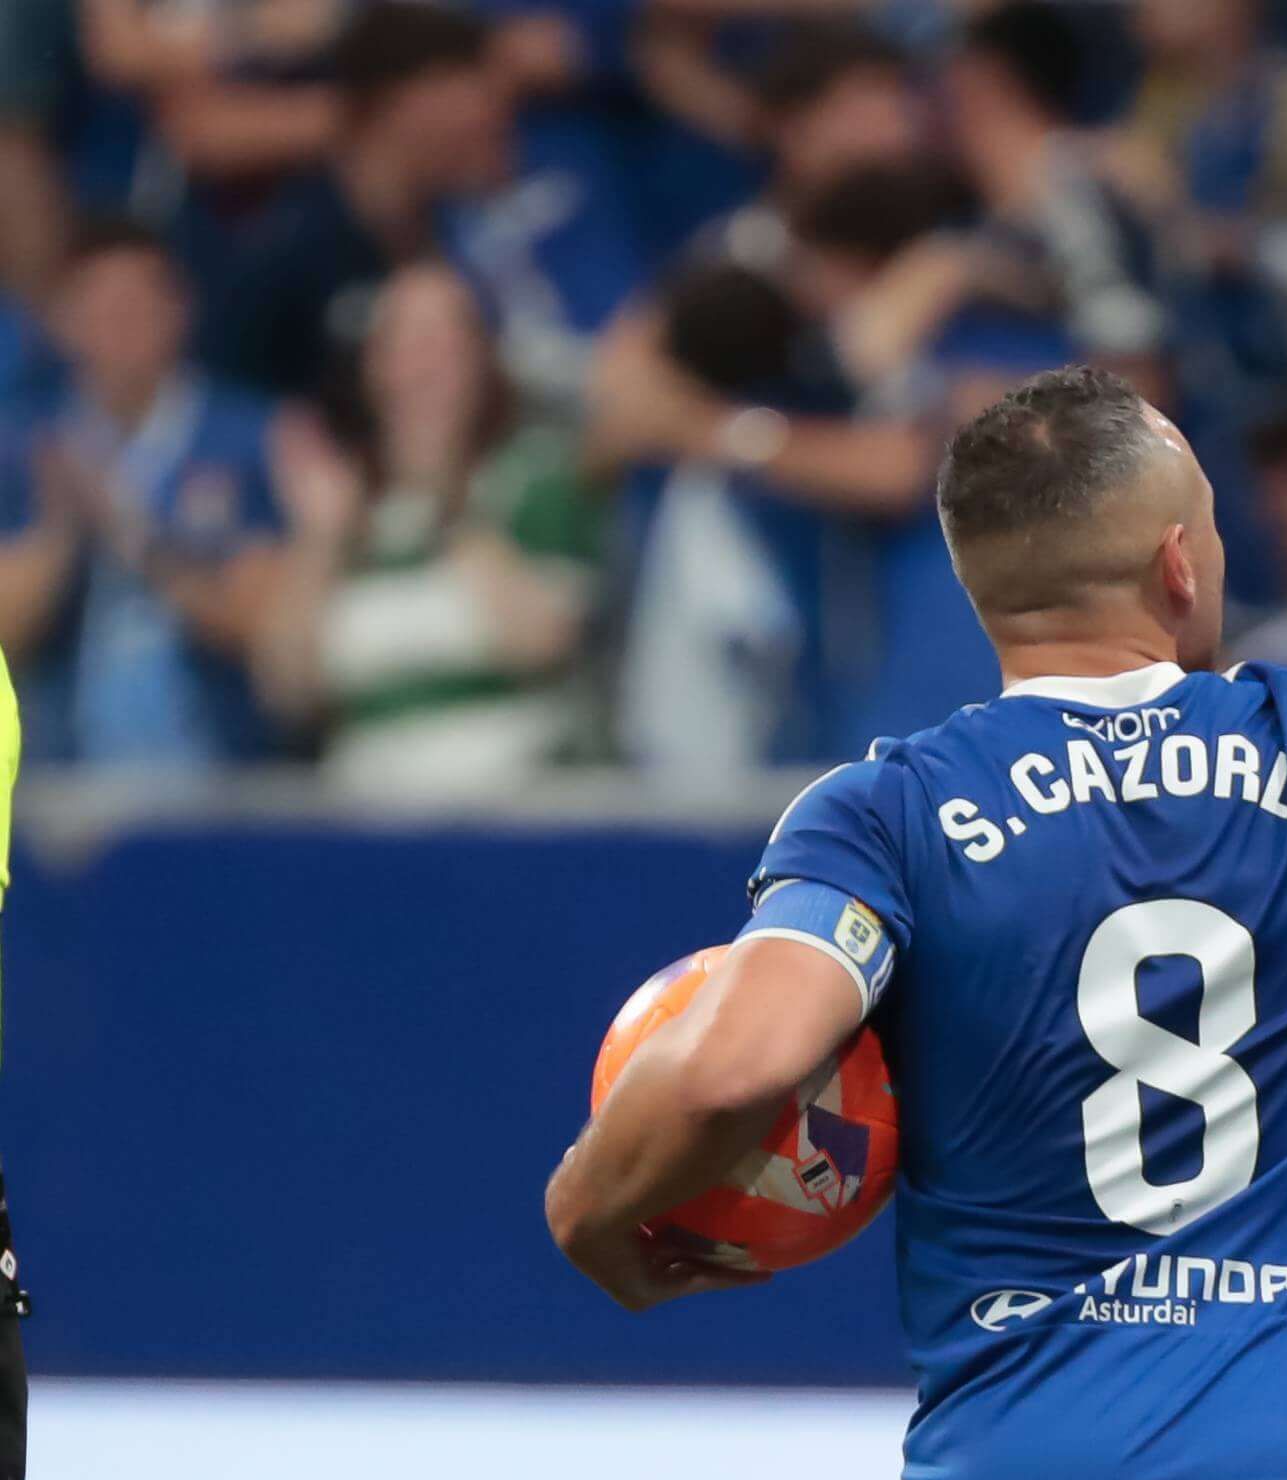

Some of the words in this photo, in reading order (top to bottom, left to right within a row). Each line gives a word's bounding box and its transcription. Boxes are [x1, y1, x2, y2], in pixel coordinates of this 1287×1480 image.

[938, 798, 1027, 863] S.
[1077, 898, 1261, 1237] 8
[1079, 1296, 1198, 1327] Asturdai
